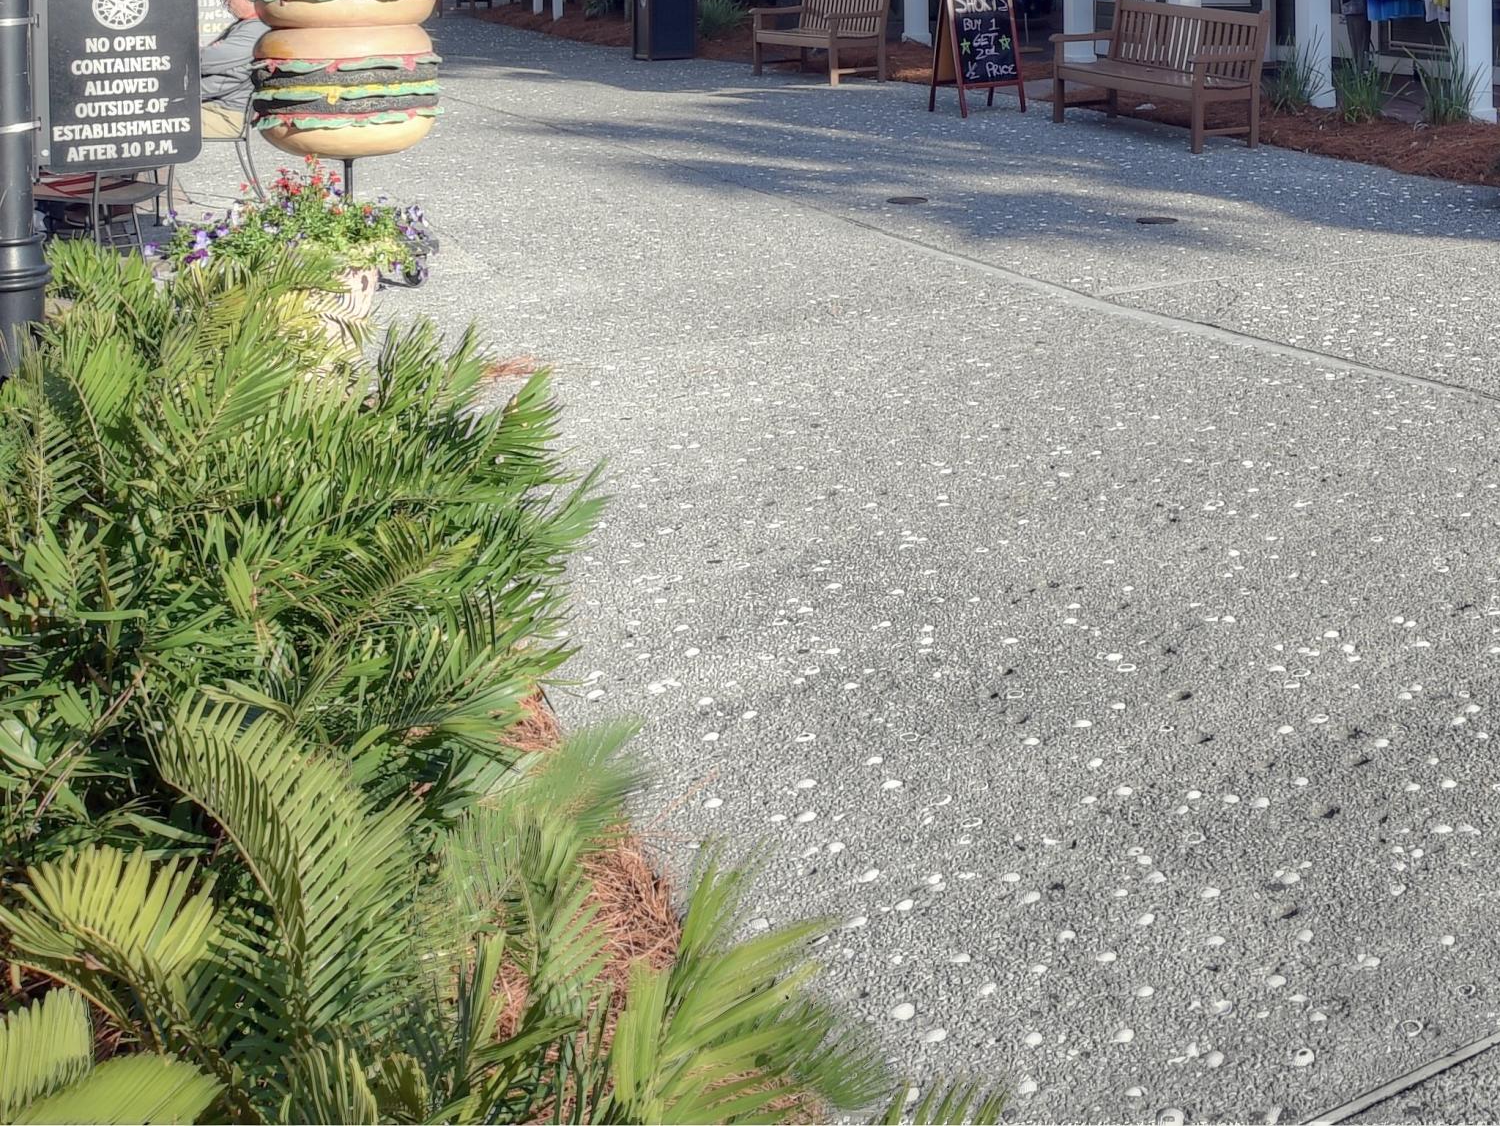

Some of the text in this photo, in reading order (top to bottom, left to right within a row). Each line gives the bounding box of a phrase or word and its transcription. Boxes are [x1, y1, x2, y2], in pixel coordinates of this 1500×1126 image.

[962, 17, 1001, 31] BUY 1
[85, 34, 157, 53] NO OPEN
[972, 32, 999, 48] GET
[71, 55, 171, 75] CONTAINERS
[985, 61, 1017, 78] PRICE
[84, 77, 159, 96] ALLOWED
[75, 97, 170, 119] OUTSIDE OF
[52, 117, 191, 142] ESTABLISHMENTS
[66, 138, 178, 163] AFTER 10 P.M.
